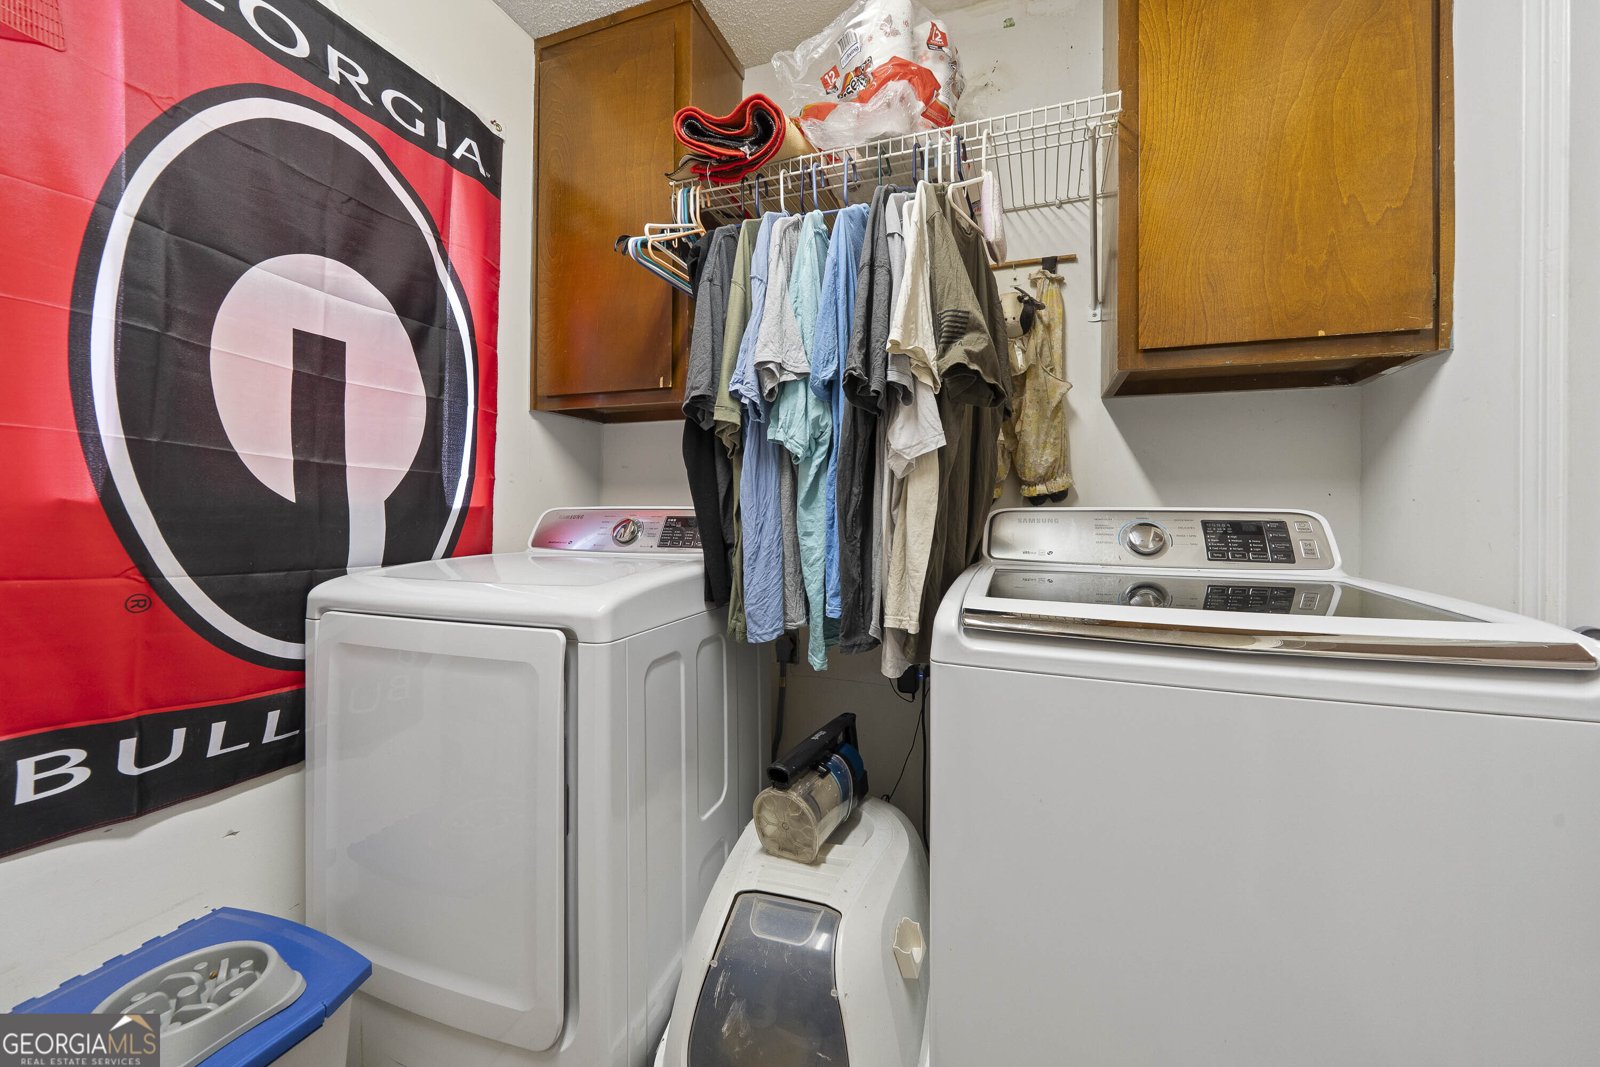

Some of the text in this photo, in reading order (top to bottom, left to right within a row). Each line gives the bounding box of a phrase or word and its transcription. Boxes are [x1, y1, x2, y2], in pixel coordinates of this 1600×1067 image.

[203, 0, 487, 178] ORGIA
[824, 70, 838, 86] 12
[14, 709, 300, 805] BULL
